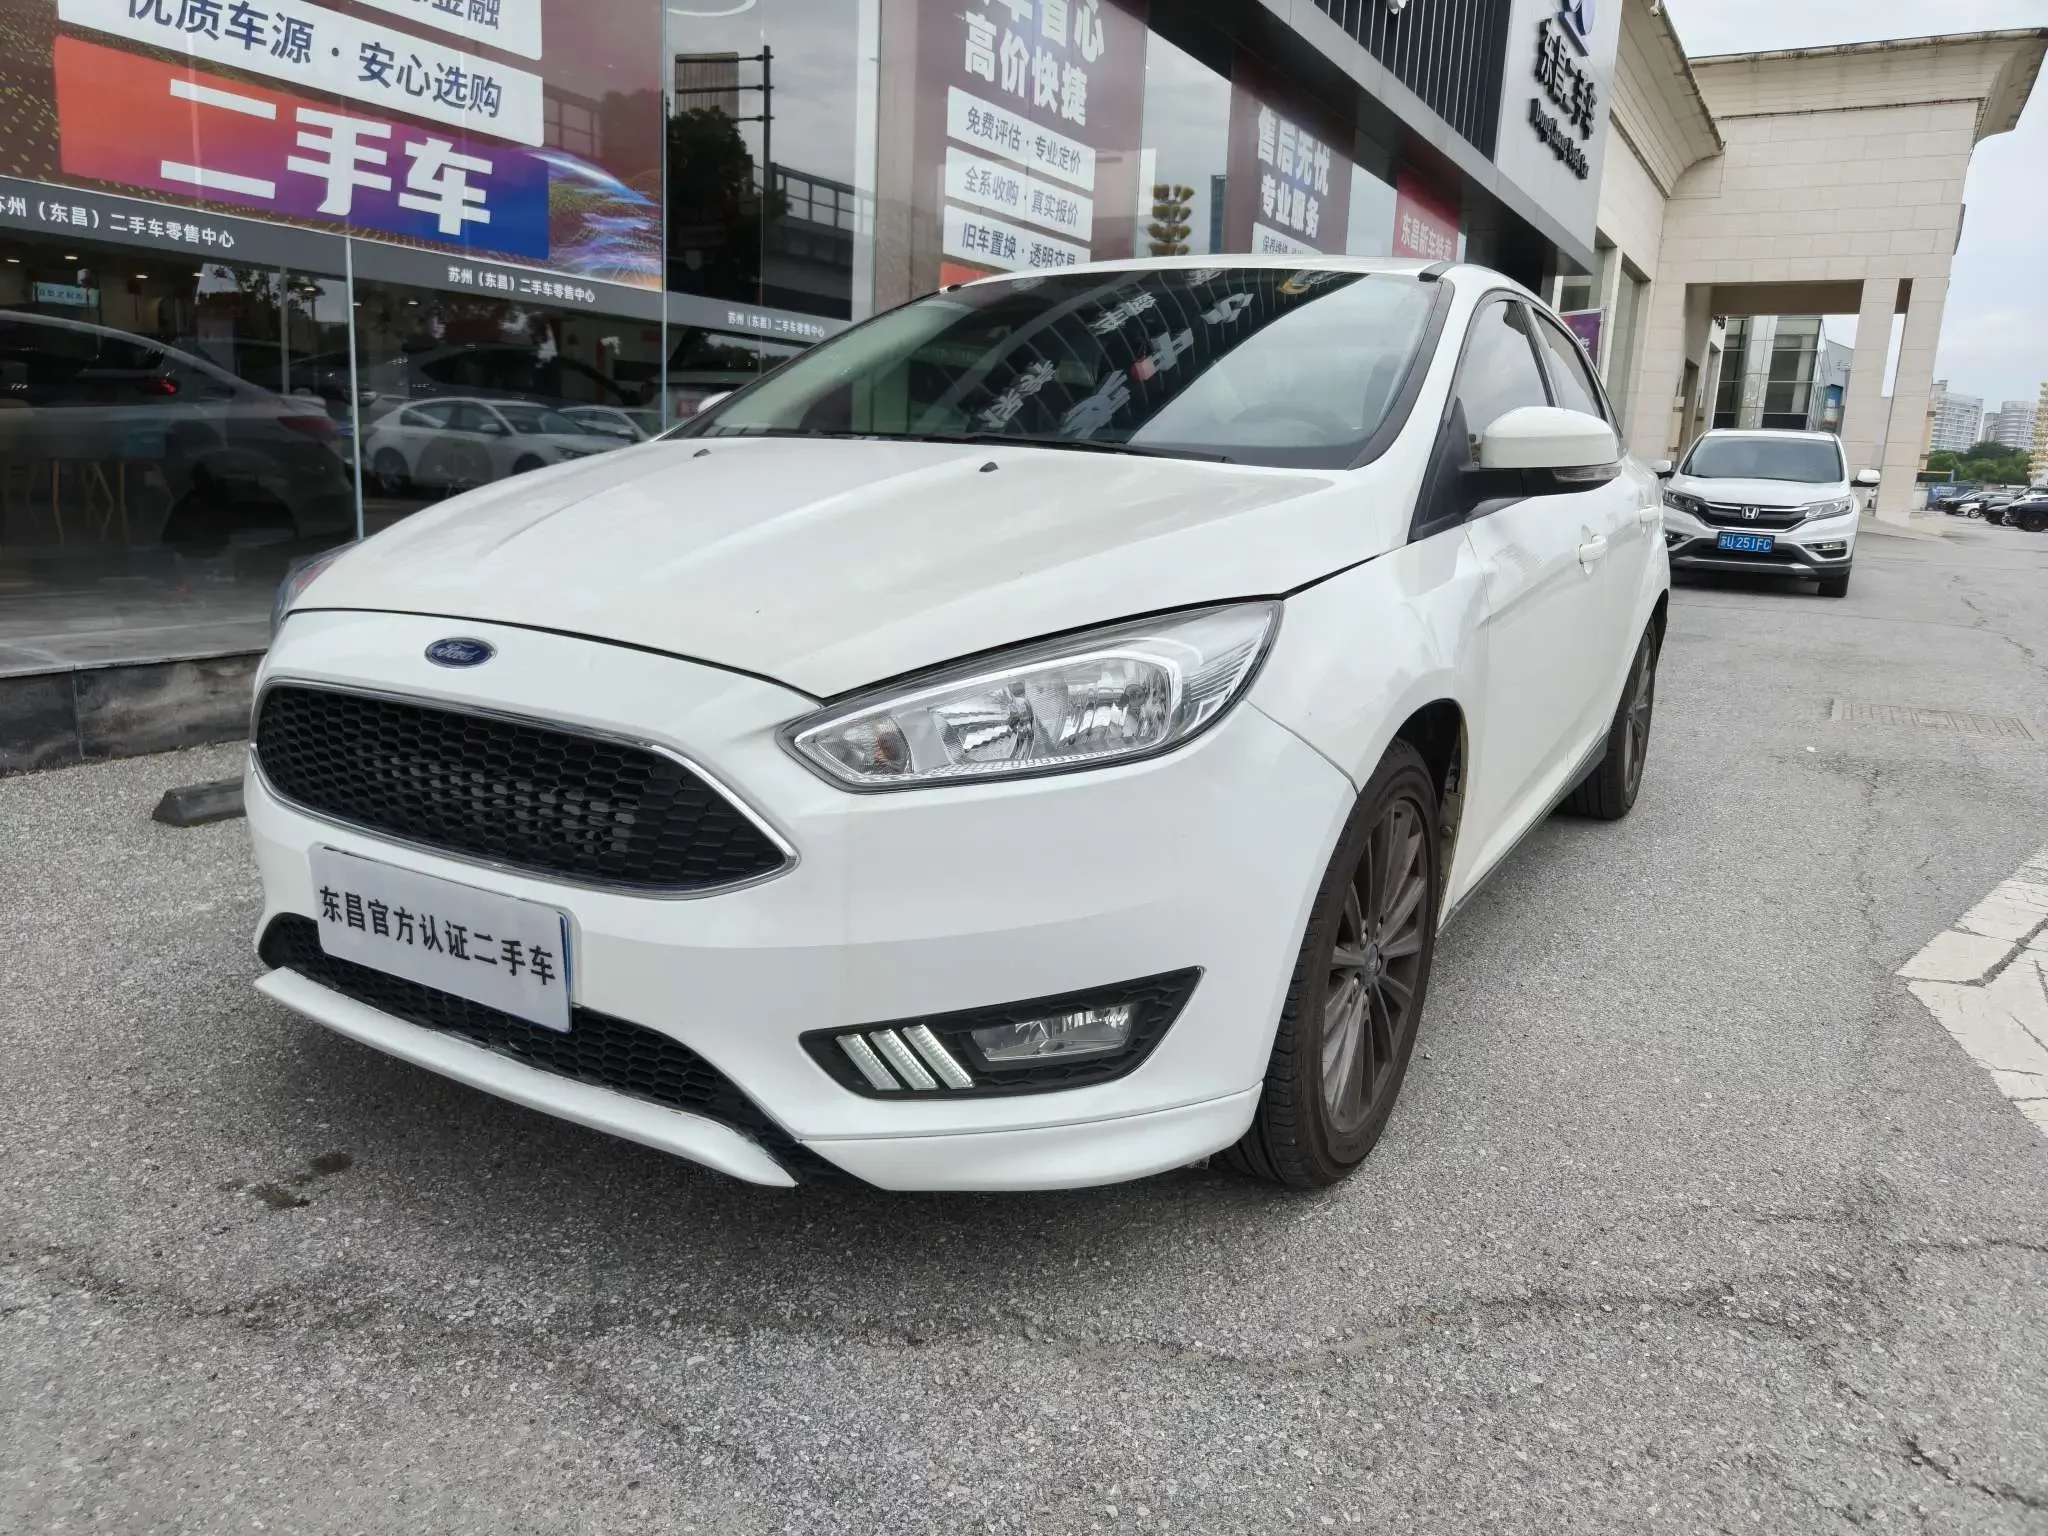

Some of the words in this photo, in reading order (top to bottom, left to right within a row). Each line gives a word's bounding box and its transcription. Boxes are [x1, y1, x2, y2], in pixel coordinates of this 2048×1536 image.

[965, 11, 1088, 127] 高价快捷
[161, 78, 493, 237] 二手车
[1258, 104, 1331, 197] 售后无忧
[1260, 173, 1319, 239] 专业服务
[319, 885, 557, 986] 东昌官方认证二手车
